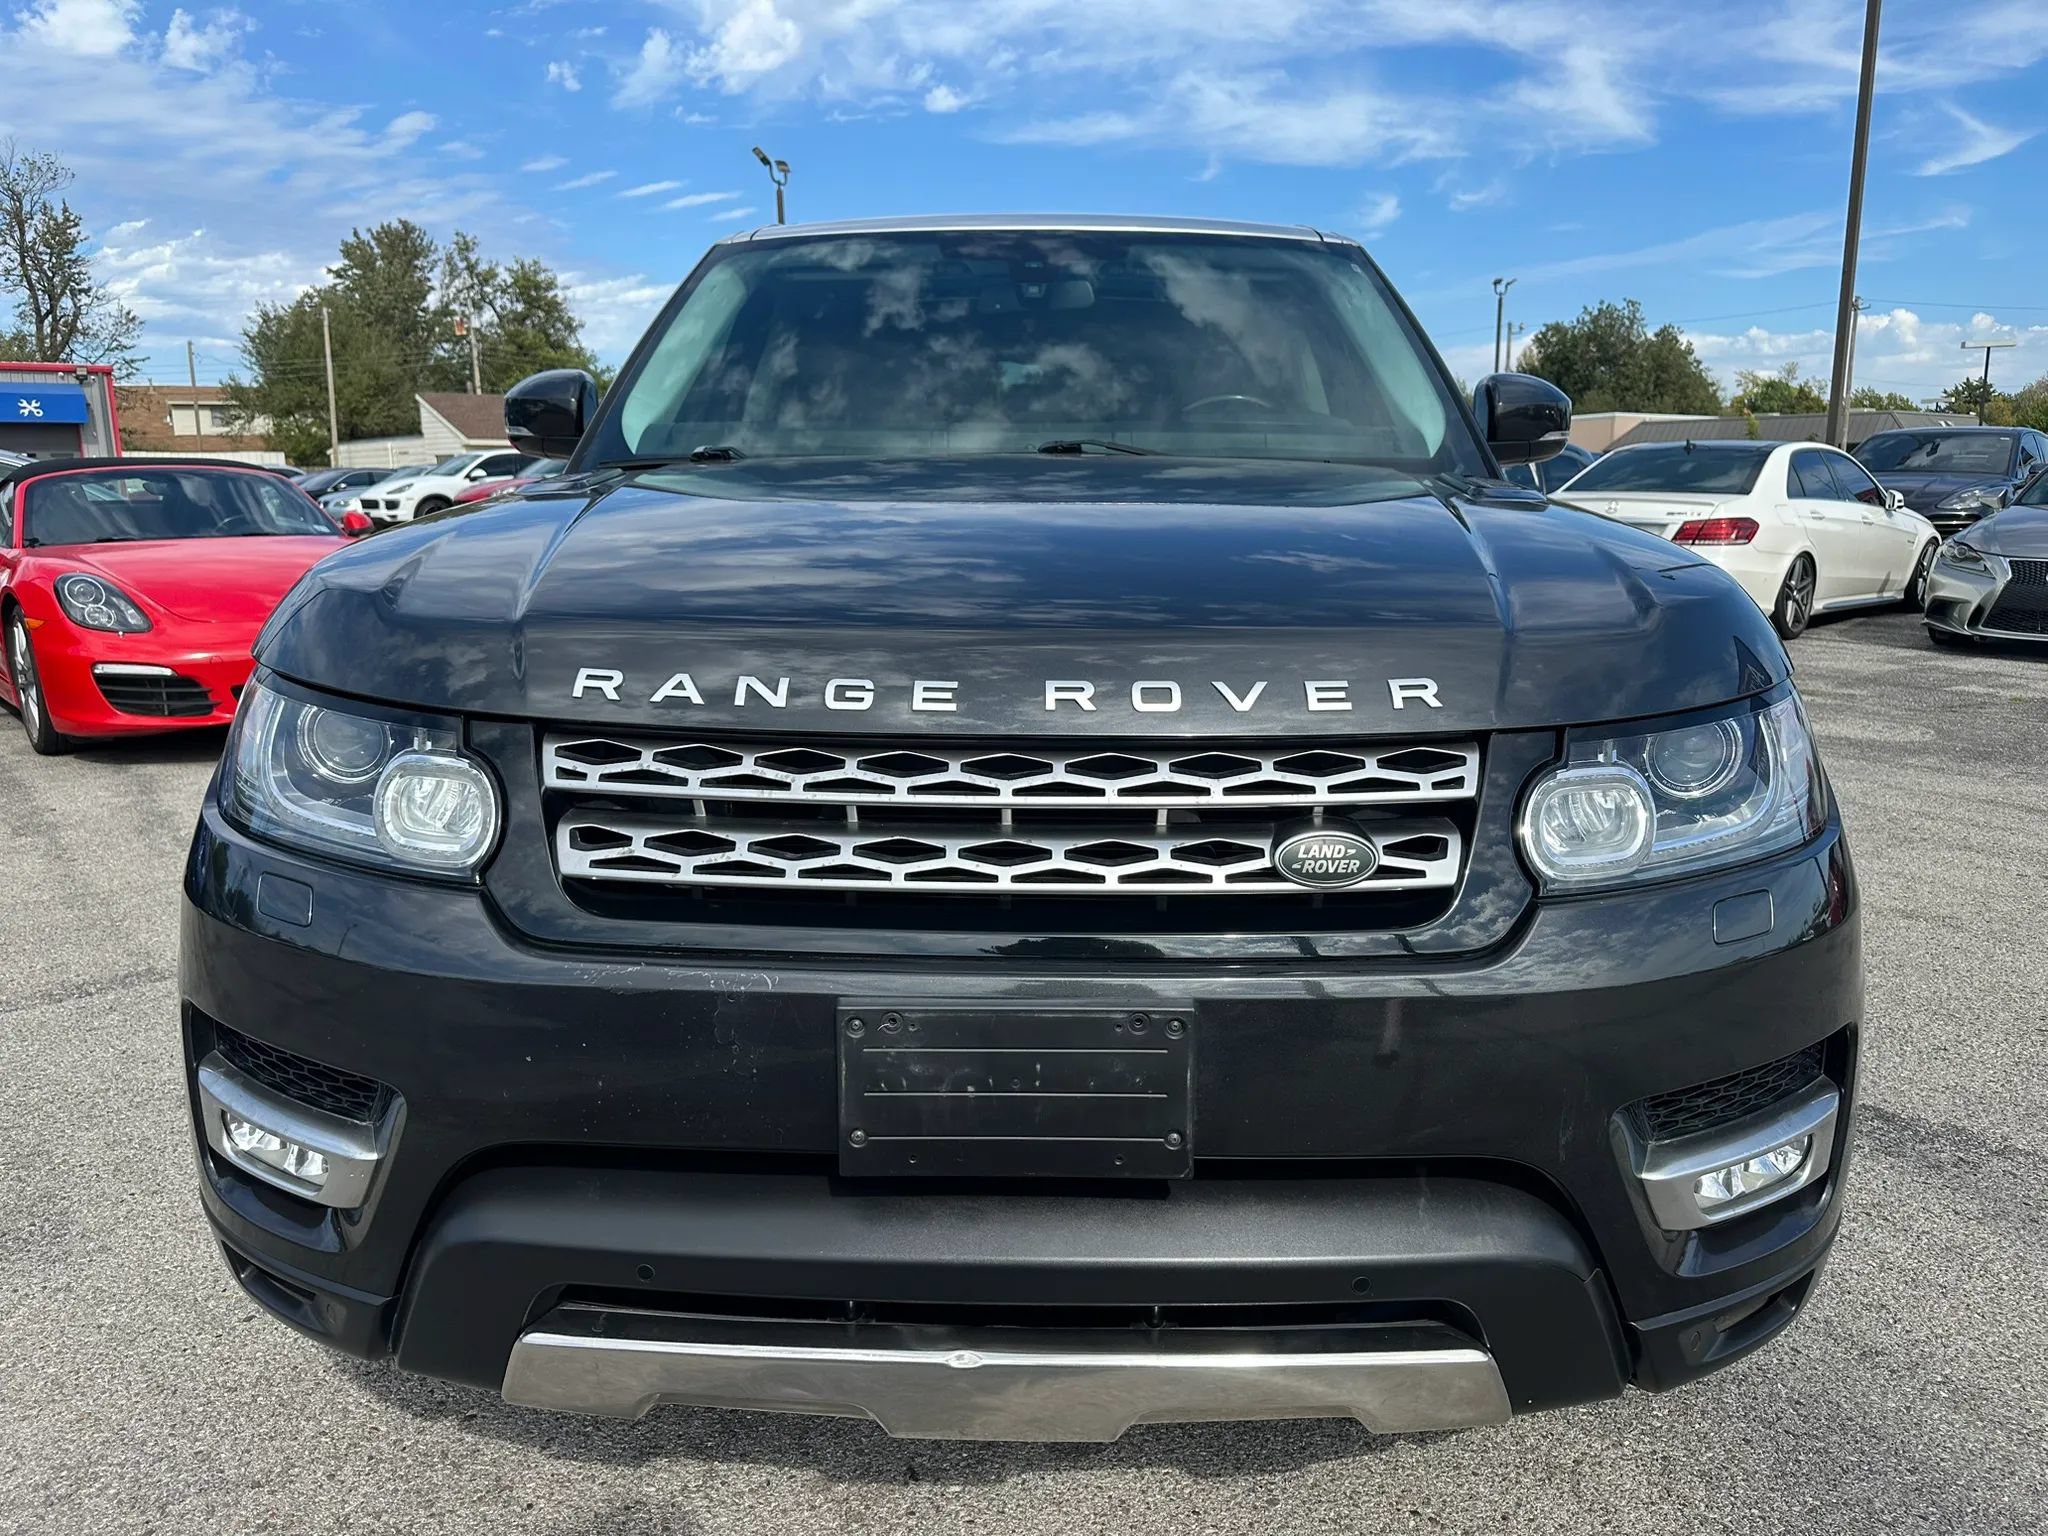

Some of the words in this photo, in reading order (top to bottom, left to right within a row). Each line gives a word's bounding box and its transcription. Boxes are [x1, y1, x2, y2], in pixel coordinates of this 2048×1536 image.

[572, 667, 959, 712] RANGE
[1045, 677, 1444, 712] ROVER
[1298, 844, 1346, 859] LAND
[1302, 859, 1360, 874] ROVER
